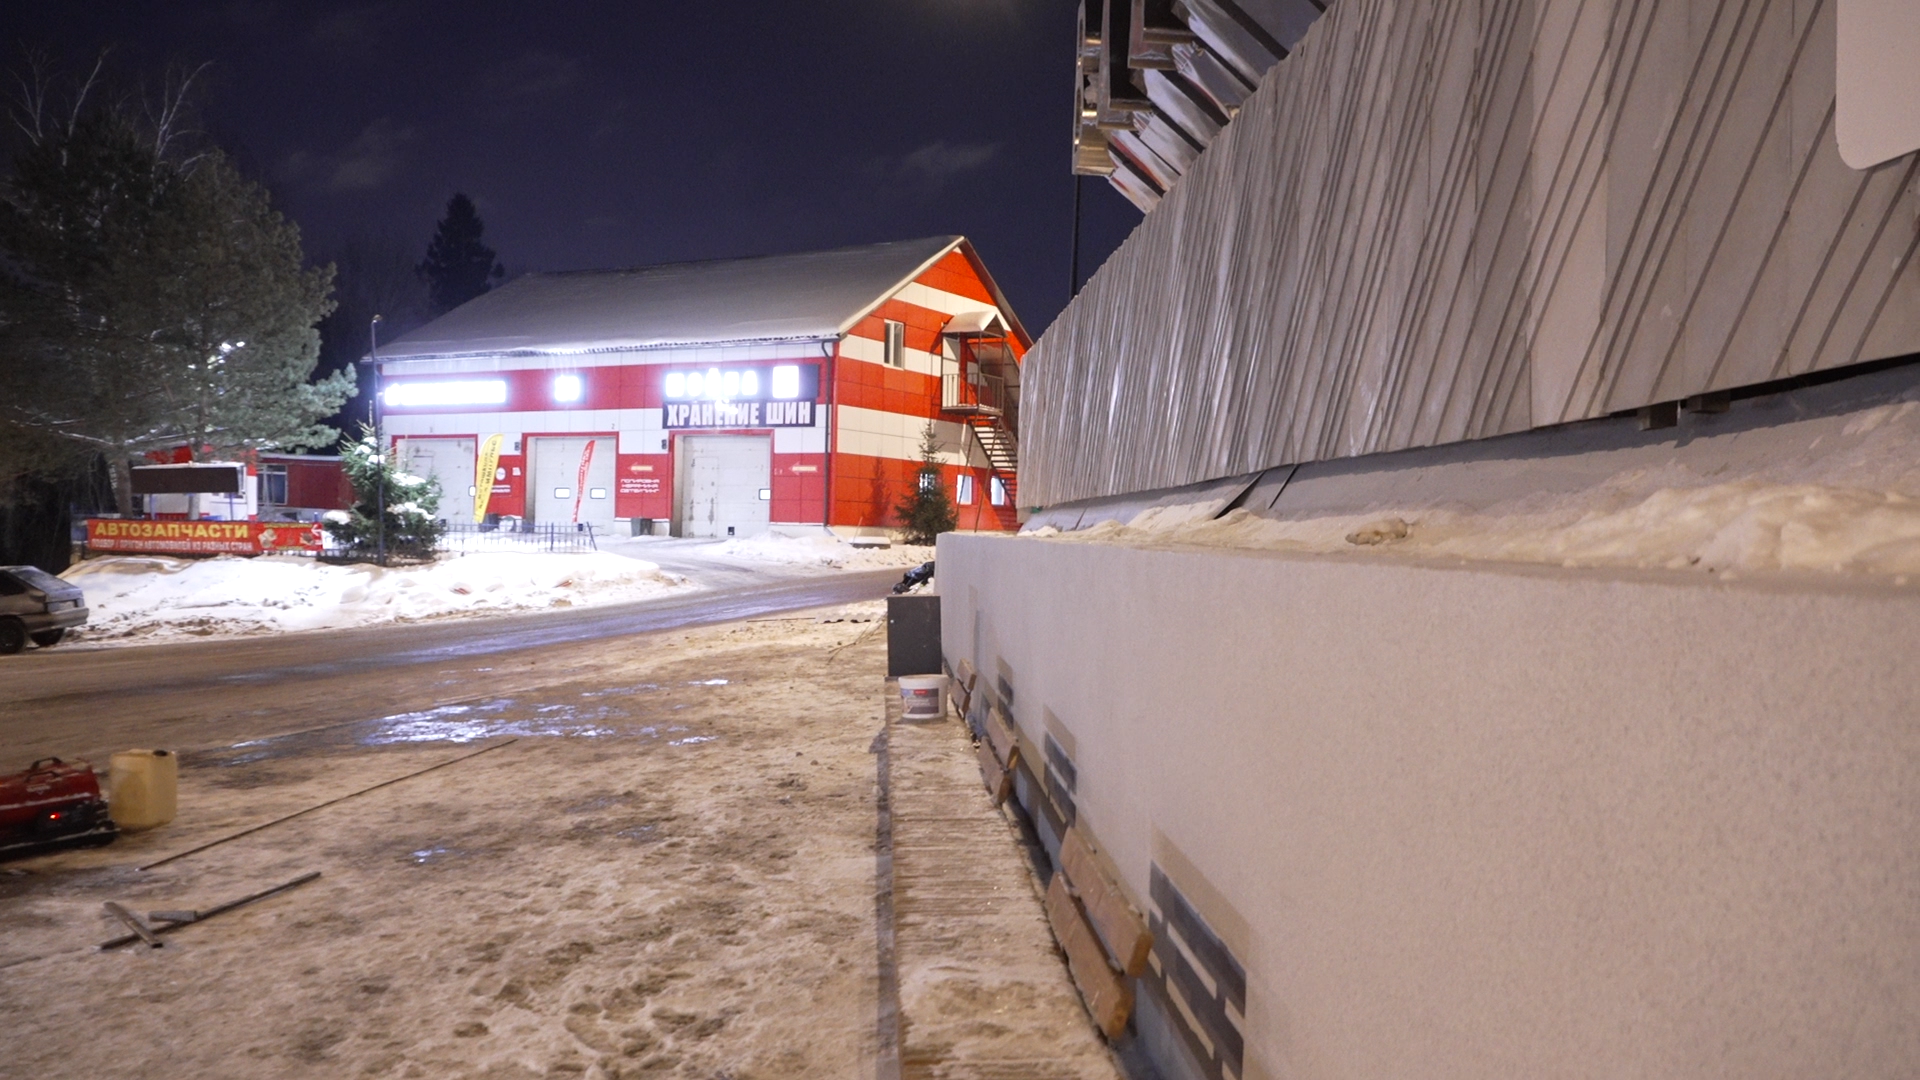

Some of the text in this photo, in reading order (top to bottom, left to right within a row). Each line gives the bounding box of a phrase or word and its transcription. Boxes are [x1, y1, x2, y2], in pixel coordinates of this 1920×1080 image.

[667, 401, 810, 426] ХРАНЕНИЕ ШИН
[95, 522, 248, 538] АВТОЗАПЧАСТИ
[230, 541, 253, 551] СТРАН
